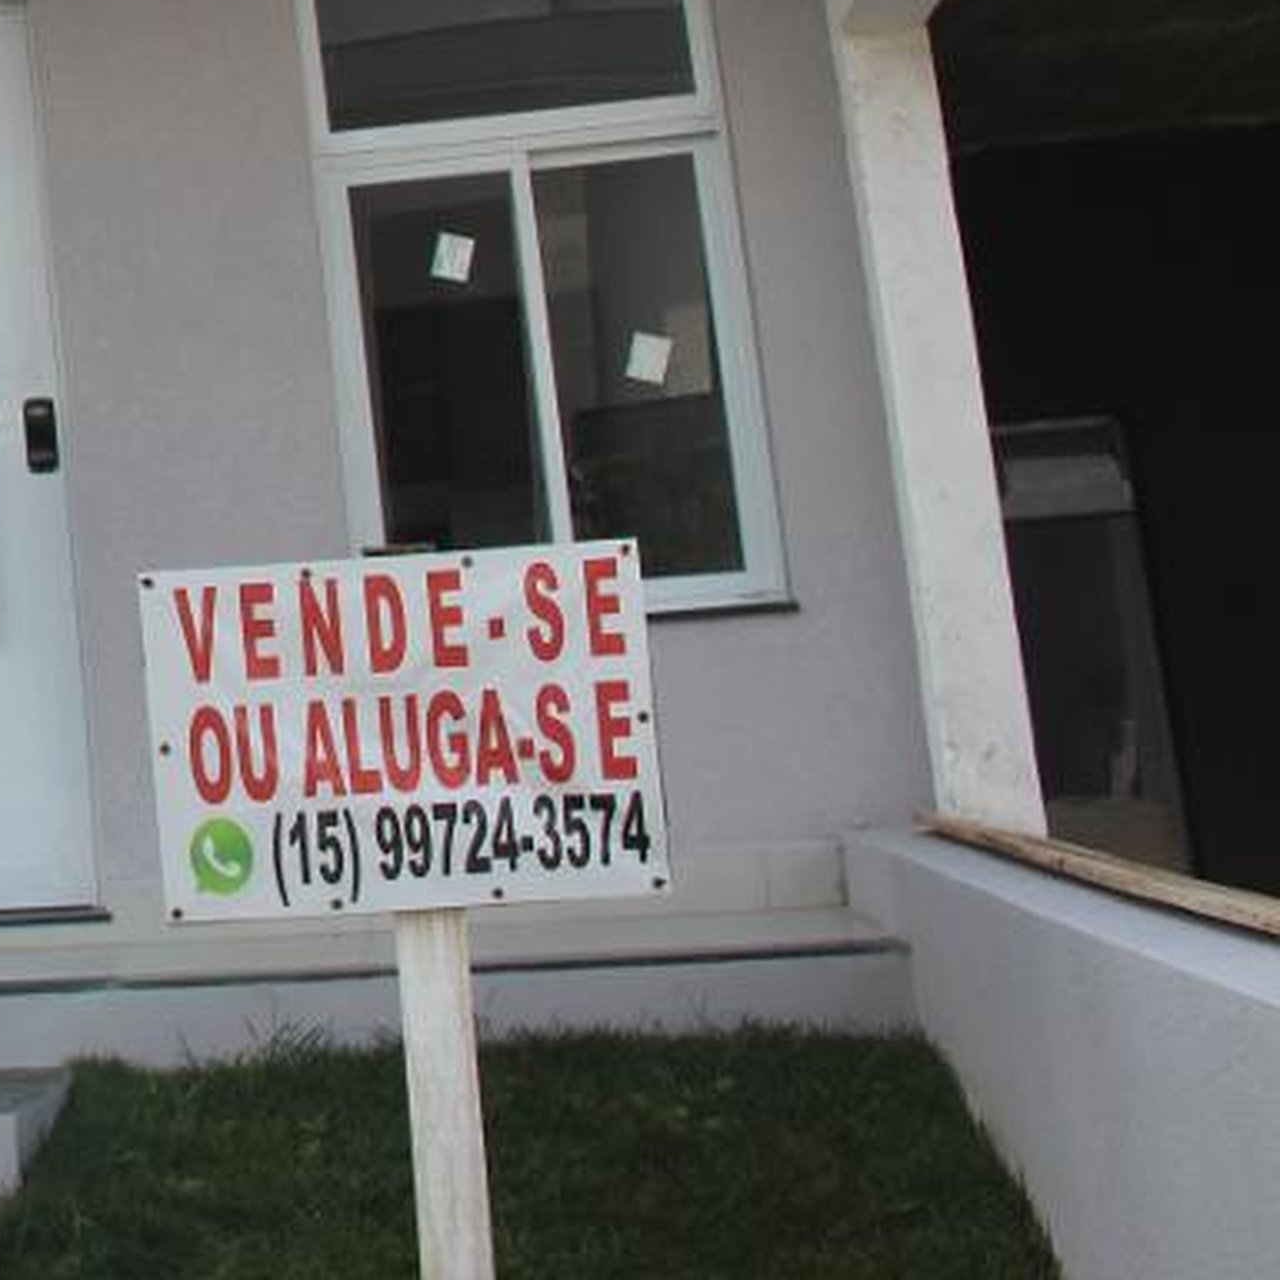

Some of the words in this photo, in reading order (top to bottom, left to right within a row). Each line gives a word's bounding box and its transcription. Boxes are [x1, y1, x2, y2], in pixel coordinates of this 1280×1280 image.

[189, 704, 279, 805] OU
[303, 679, 638, 798] ALUGA-SE
[272, 809, 361, 907] (15)
[375, 791, 651, 882] 99724-3574
